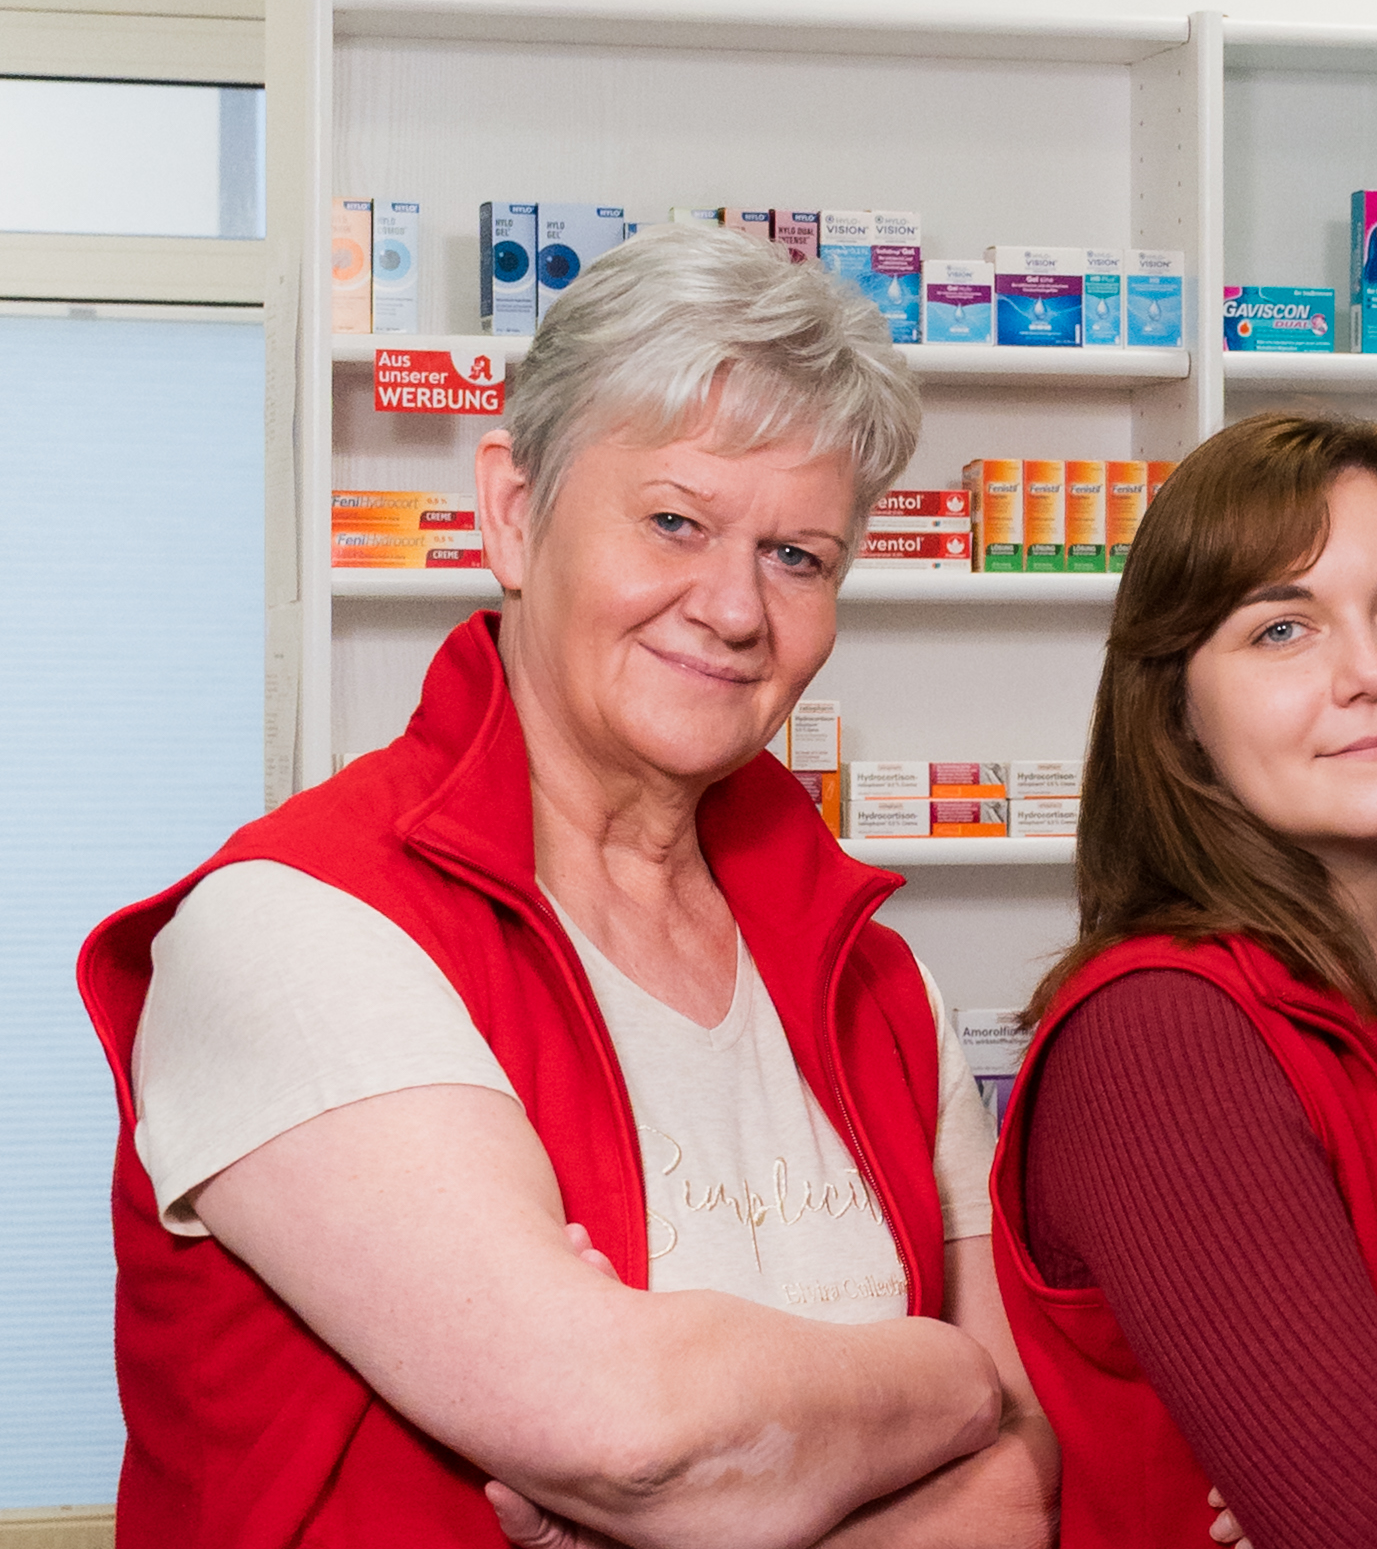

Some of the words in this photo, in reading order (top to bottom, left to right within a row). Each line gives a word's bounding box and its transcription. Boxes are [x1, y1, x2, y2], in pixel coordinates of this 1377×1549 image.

[511, 206, 534, 214] HYLO
[599, 209, 621, 217] HYLO
[794, 214, 815, 222] HYLO
[495, 219, 513, 228] HYLO
[547, 221, 565, 230] HYLO
[495, 228, 509, 237] GEL
[547, 231, 561, 239] GEL
[827, 226, 866, 235] VISION
[876, 226, 915, 235] VISION
[1223, 301, 1310, 319] GAVISCON
[379, 352, 411, 367] Aus
[379, 369, 448, 384] unserer
[379, 387, 499, 410] WERBUNG
[988, 484, 1018, 493] Fenistil
[1029, 485, 1060, 493] Fenistil
[1070, 485, 1101, 494] Fenistil
[1112, 484, 1143, 493] Fenistil
[331, 495, 419, 508] FeniHydrocort
[878, 495, 921, 509] entol
[426, 512, 453, 521] CREME
[337, 534, 426, 548] FeniHydrocort
[432, 551, 459, 559] CREME
